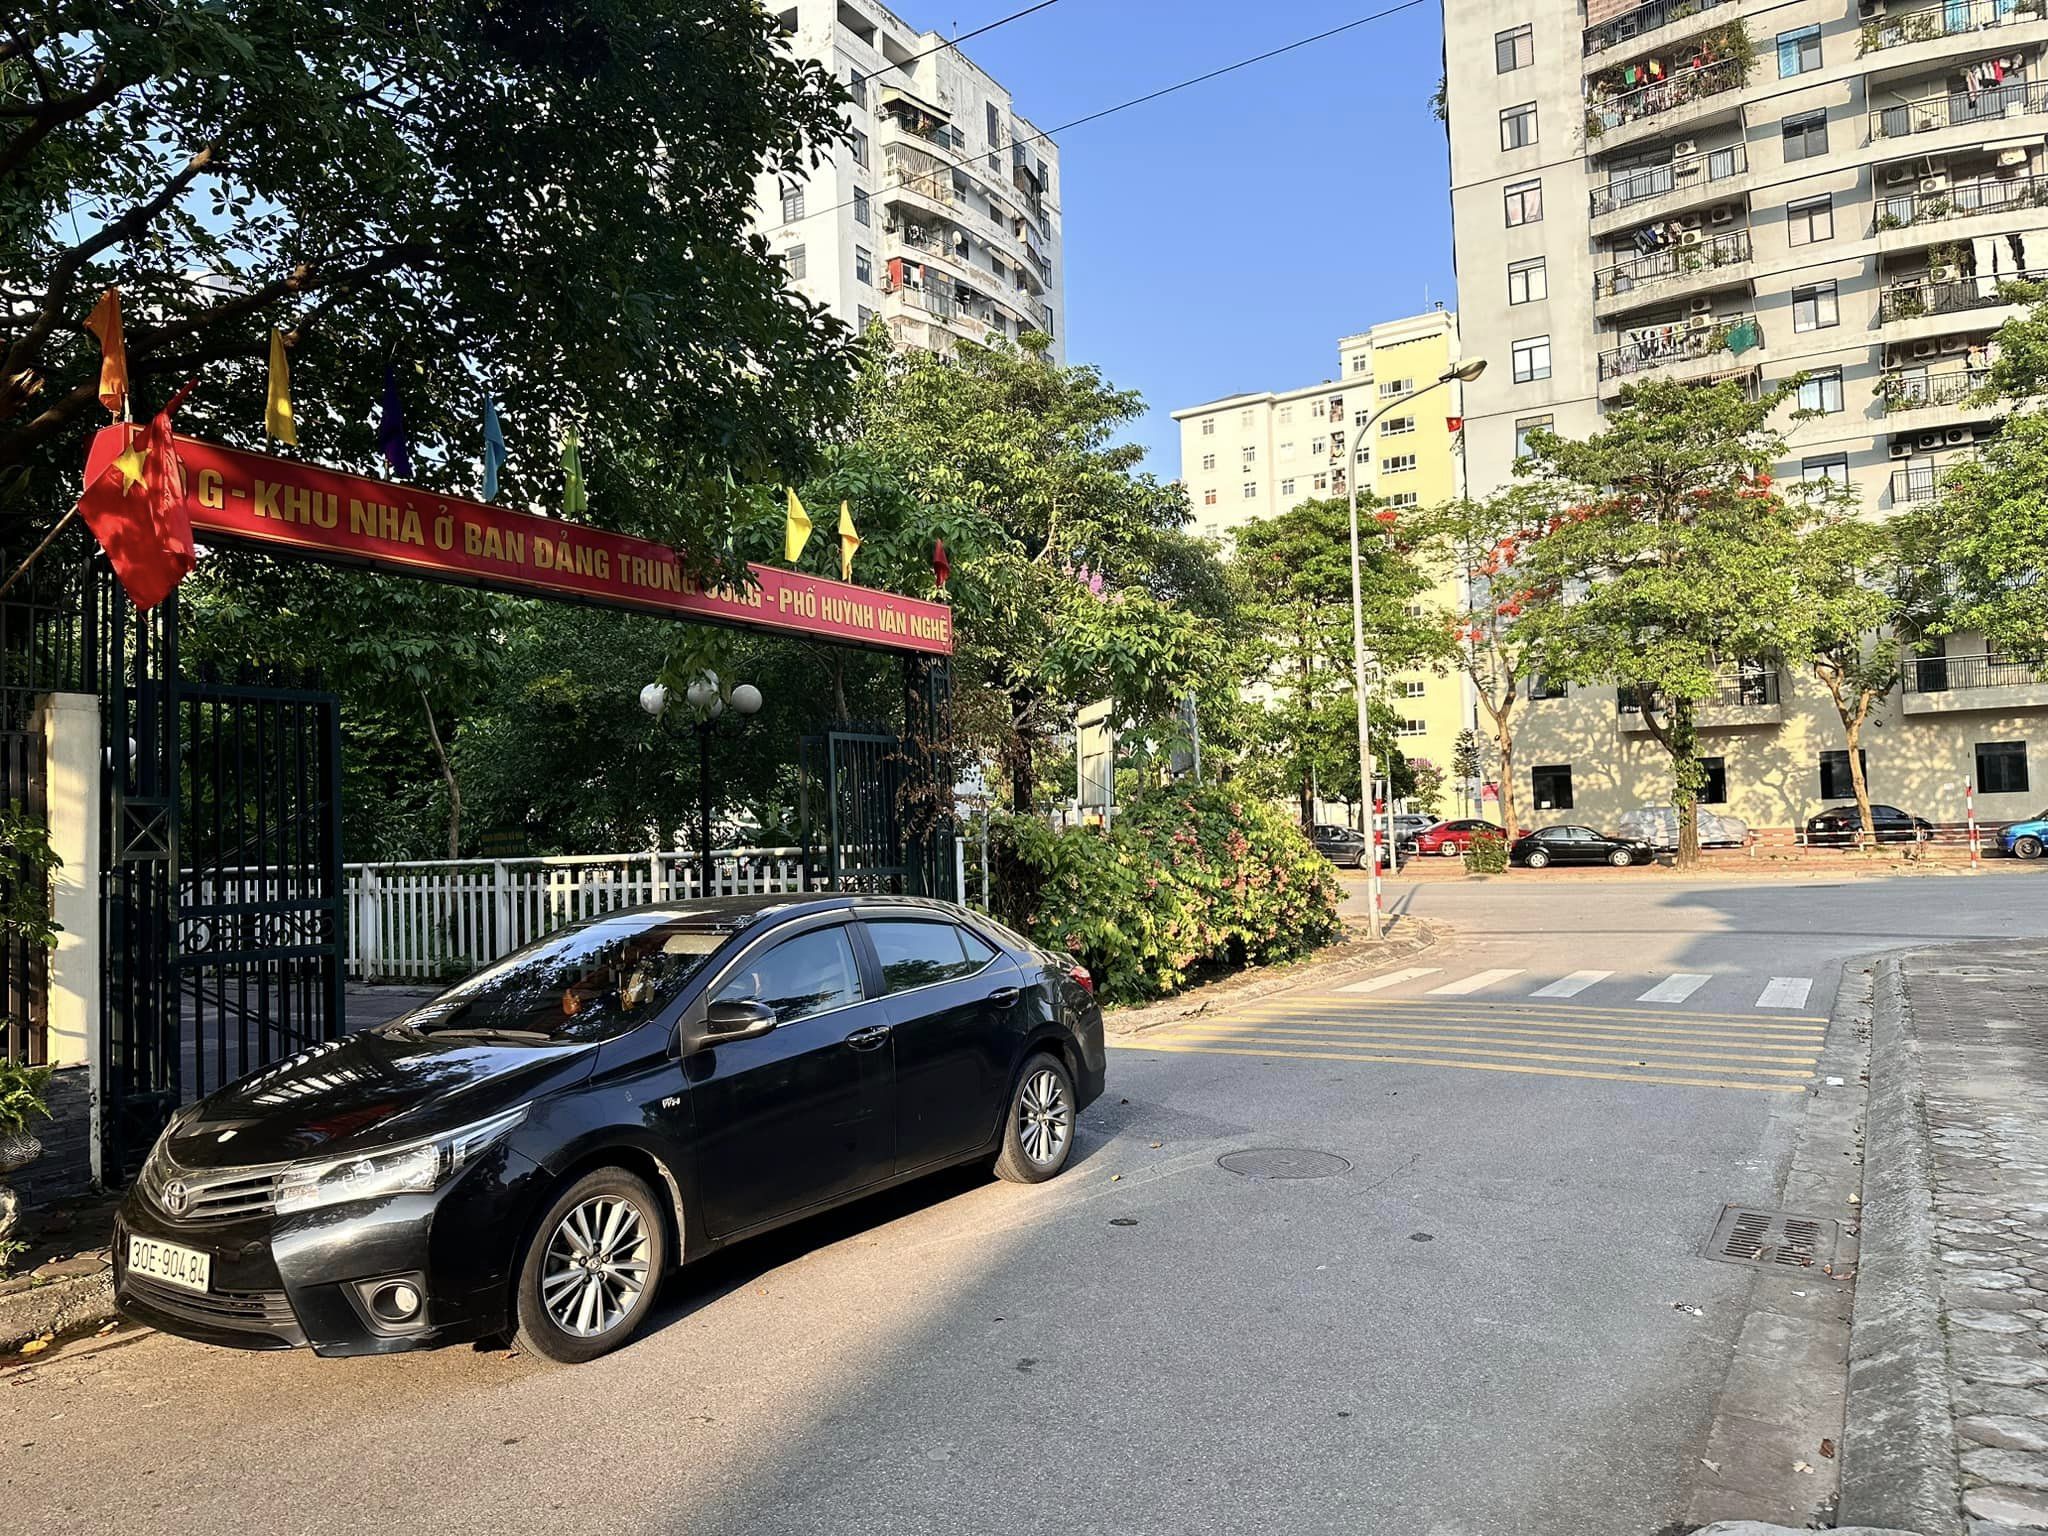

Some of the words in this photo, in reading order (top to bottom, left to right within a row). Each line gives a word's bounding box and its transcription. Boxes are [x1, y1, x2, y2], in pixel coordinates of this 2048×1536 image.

[253, 480, 338, 529] KHU
[350, 497, 425, 546] NHÀ
[434, 505, 455, 551] Ở
[464, 521, 526, 565] BAN
[533, 530, 610, 579] ĐẢNG
[618, 554, 697, 596] TRUNG
[779, 585, 818, 618] PHỐ
[821, 595, 874, 630] HUỲNH
[877, 604, 907, 636] VĂN
[909, 614, 949, 646] NGHỆ
